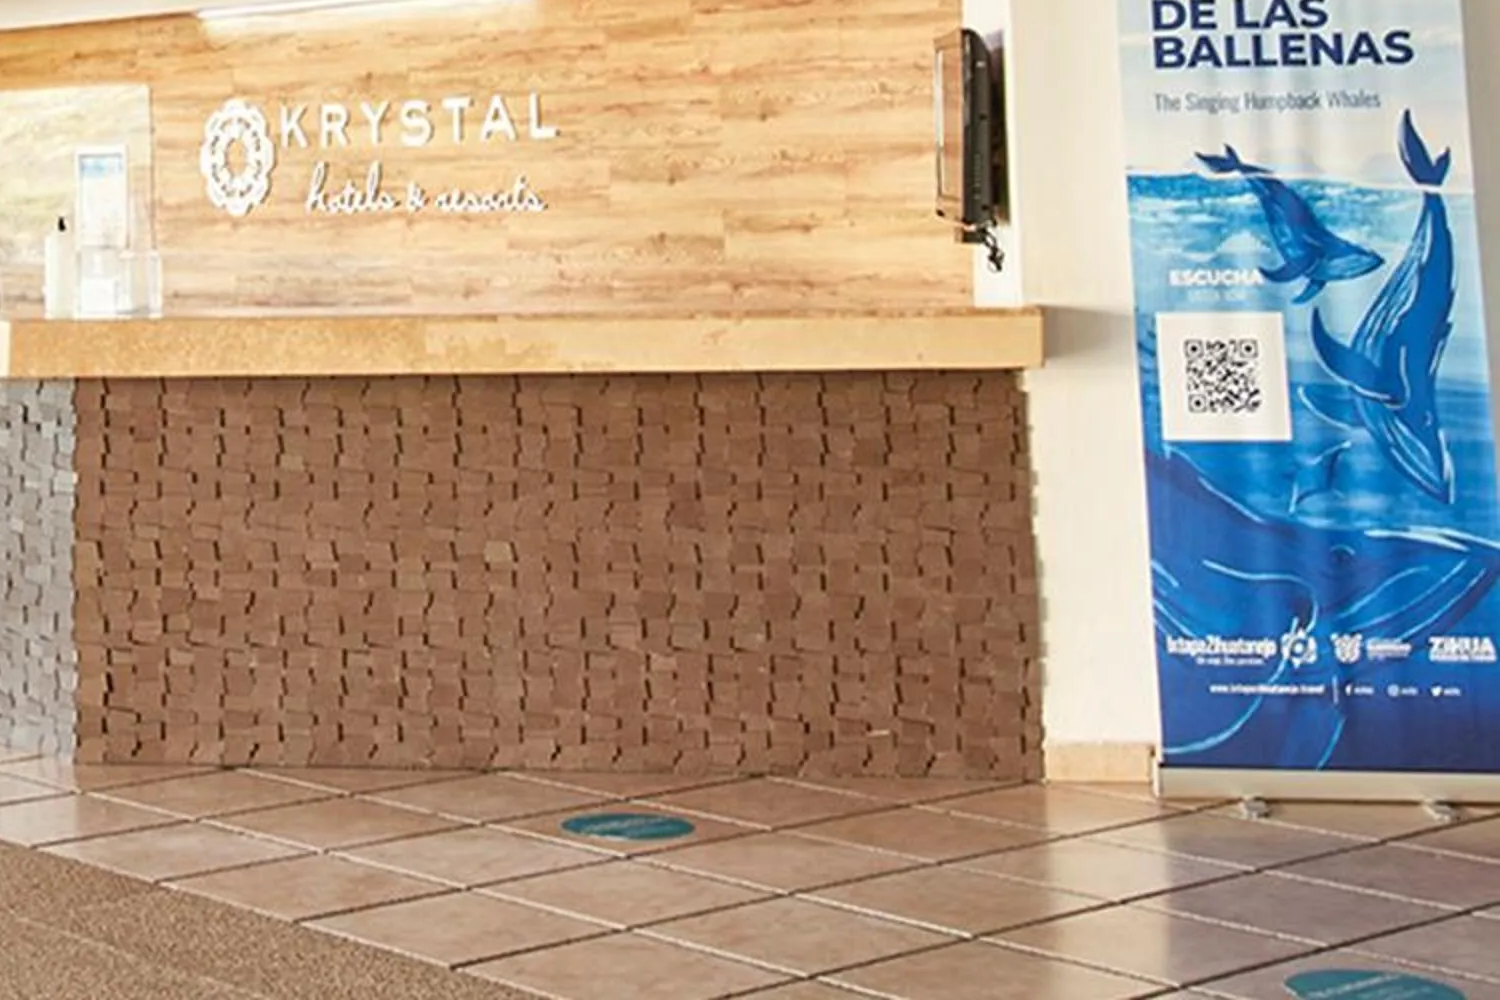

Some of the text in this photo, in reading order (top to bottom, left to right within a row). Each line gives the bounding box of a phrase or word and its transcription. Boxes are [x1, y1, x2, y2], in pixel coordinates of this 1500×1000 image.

[1153, 31, 1414, 69] BALLENAS
[280, 93, 558, 148] KRYSTAL
[1155, 90, 1381, 114] The Singing Humpback Whales
[306, 160, 400, 213] hotels
[435, 175, 547, 212] resorts
[1169, 269, 1264, 287] ESCUCHA
